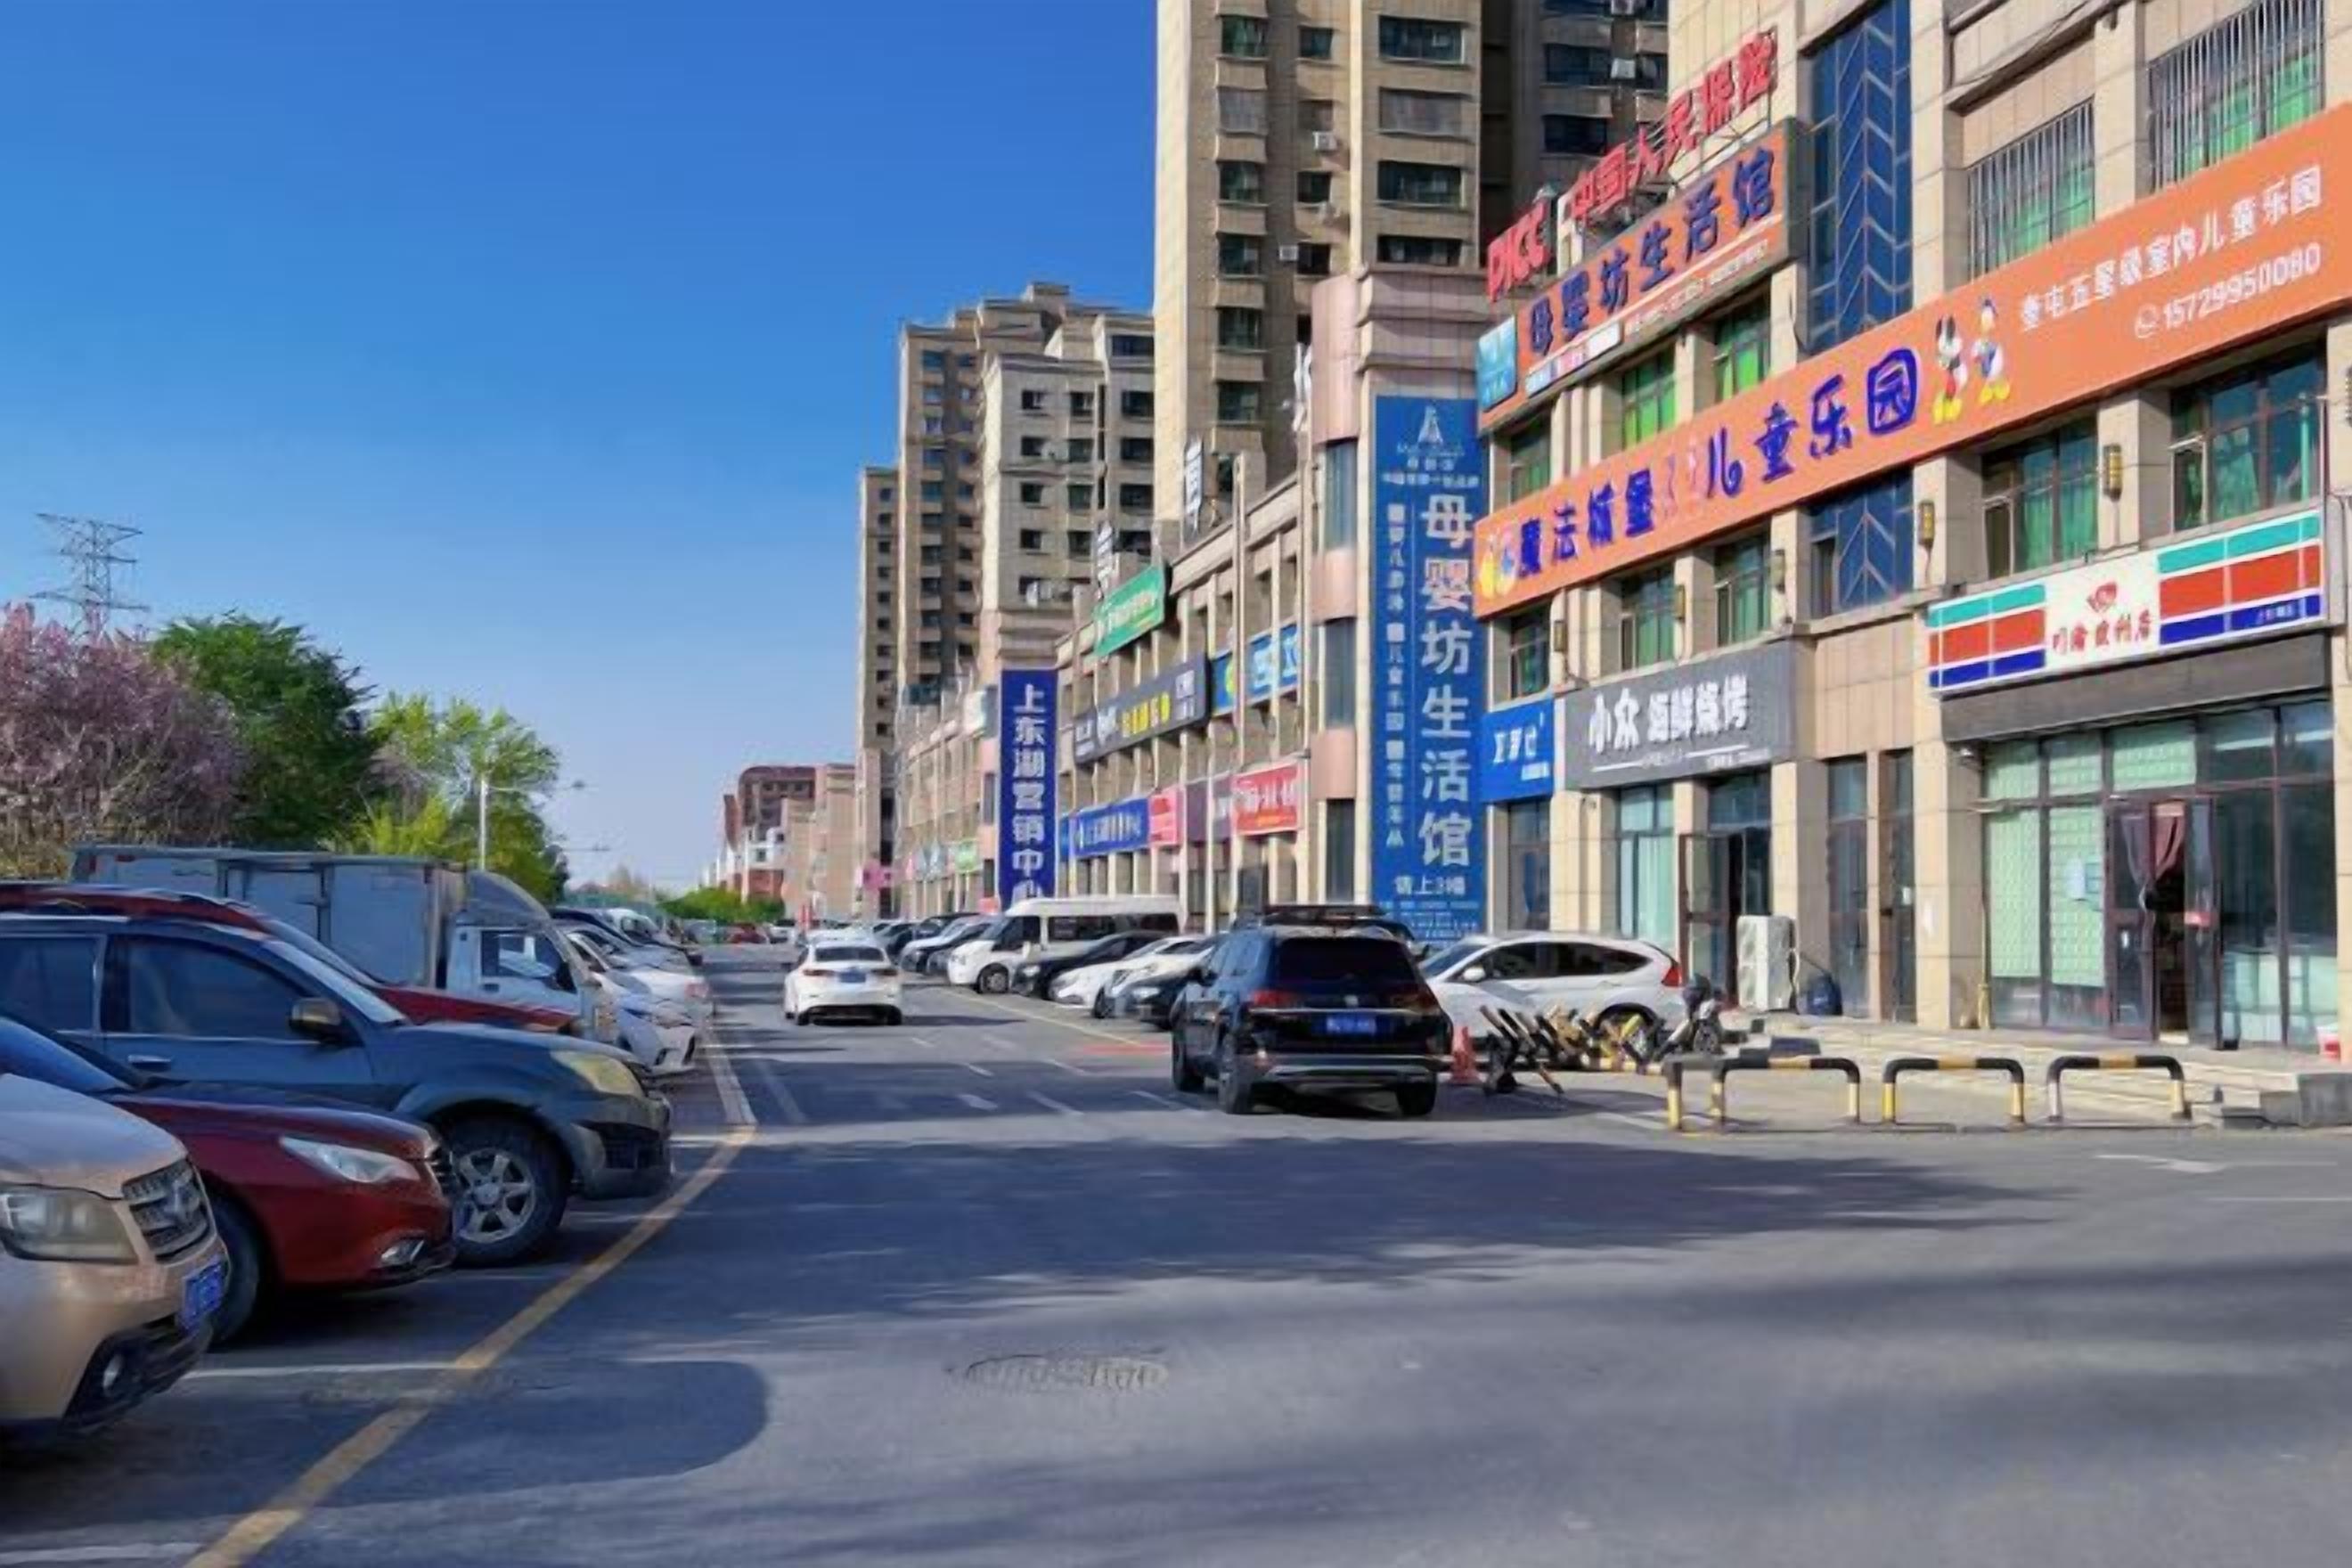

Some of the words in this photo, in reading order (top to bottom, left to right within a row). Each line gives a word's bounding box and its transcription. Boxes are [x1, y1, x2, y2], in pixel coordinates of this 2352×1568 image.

[1529, 147, 1775, 355] 母婴坊生活馆
[1706, 348, 1918, 499] 儿童乐园
[1418, 494, 1473, 865] 母婴坊生活馆
